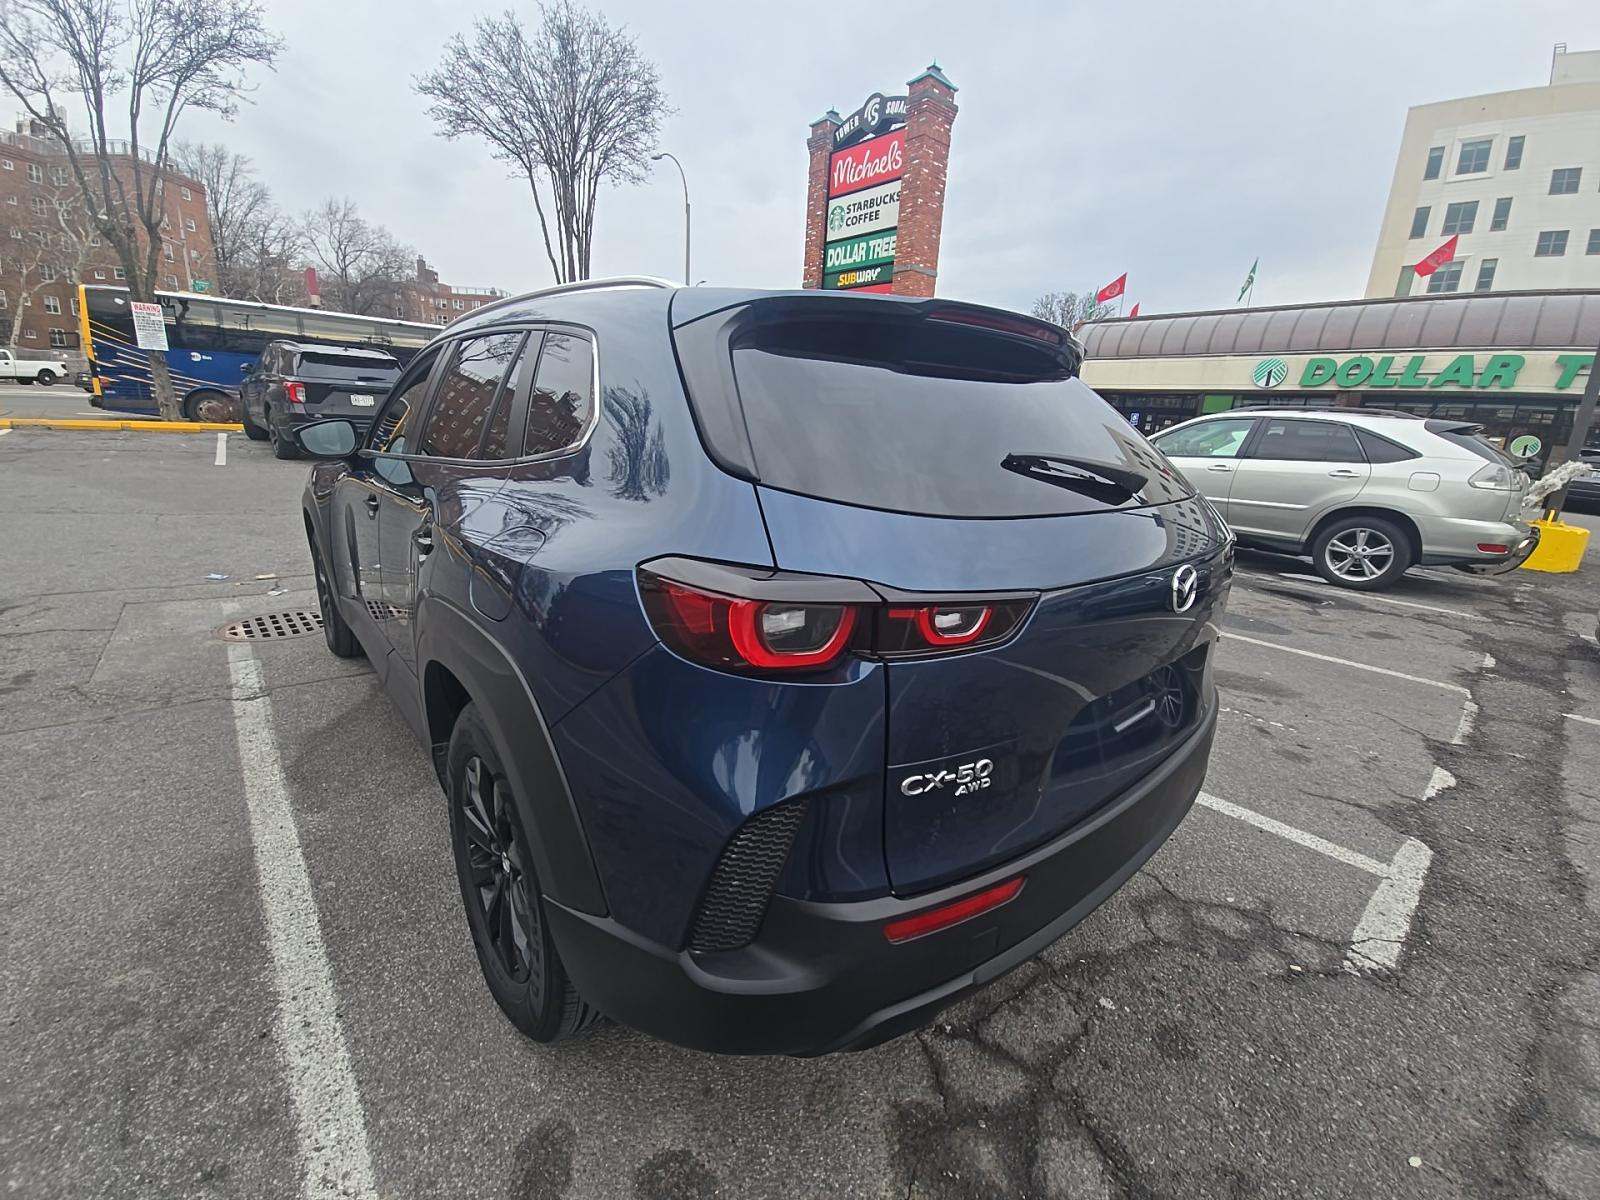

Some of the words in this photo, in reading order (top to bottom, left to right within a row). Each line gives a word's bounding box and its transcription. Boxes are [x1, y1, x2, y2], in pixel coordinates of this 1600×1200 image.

[835, 115, 859, 141] TOWER
[833, 140, 903, 188] Michaels
[846, 190, 900, 214] STARBUCKS
[845, 209, 880, 227] COFFEE
[827, 242, 867, 267] DOLLAR
[868, 236, 896, 259] TREE
[838, 267, 881, 286] SUBWAY
[133, 303, 161, 313] WARNING
[1299, 354, 1526, 389] DOLLAR
[900, 758, 994, 797] CX-50
[954, 777, 991, 797] AWD
